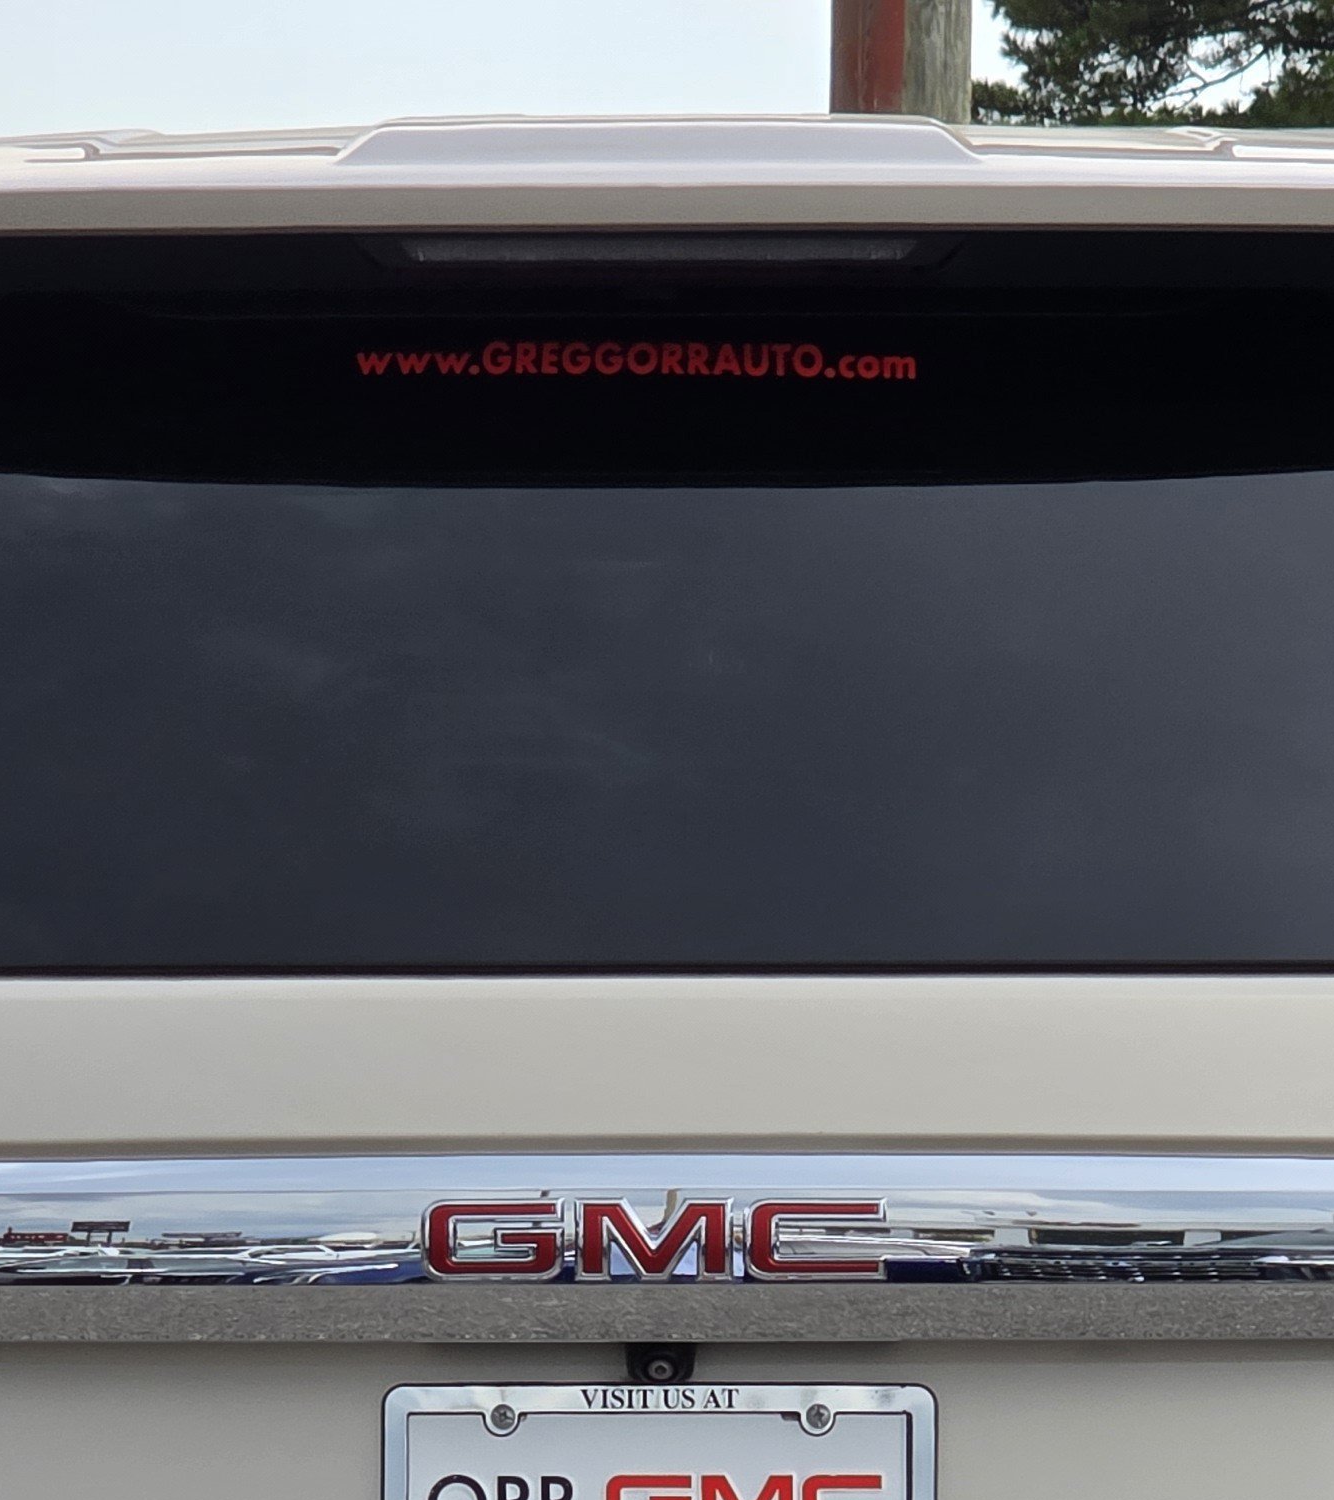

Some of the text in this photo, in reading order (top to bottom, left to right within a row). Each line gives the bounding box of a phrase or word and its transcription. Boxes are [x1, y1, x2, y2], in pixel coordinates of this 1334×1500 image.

[356, 341, 917, 380] www.GREGGORRAUTO.com
[421, 1197, 888, 1283] GMC
[580, 1388, 740, 1410] VISIT US AT
